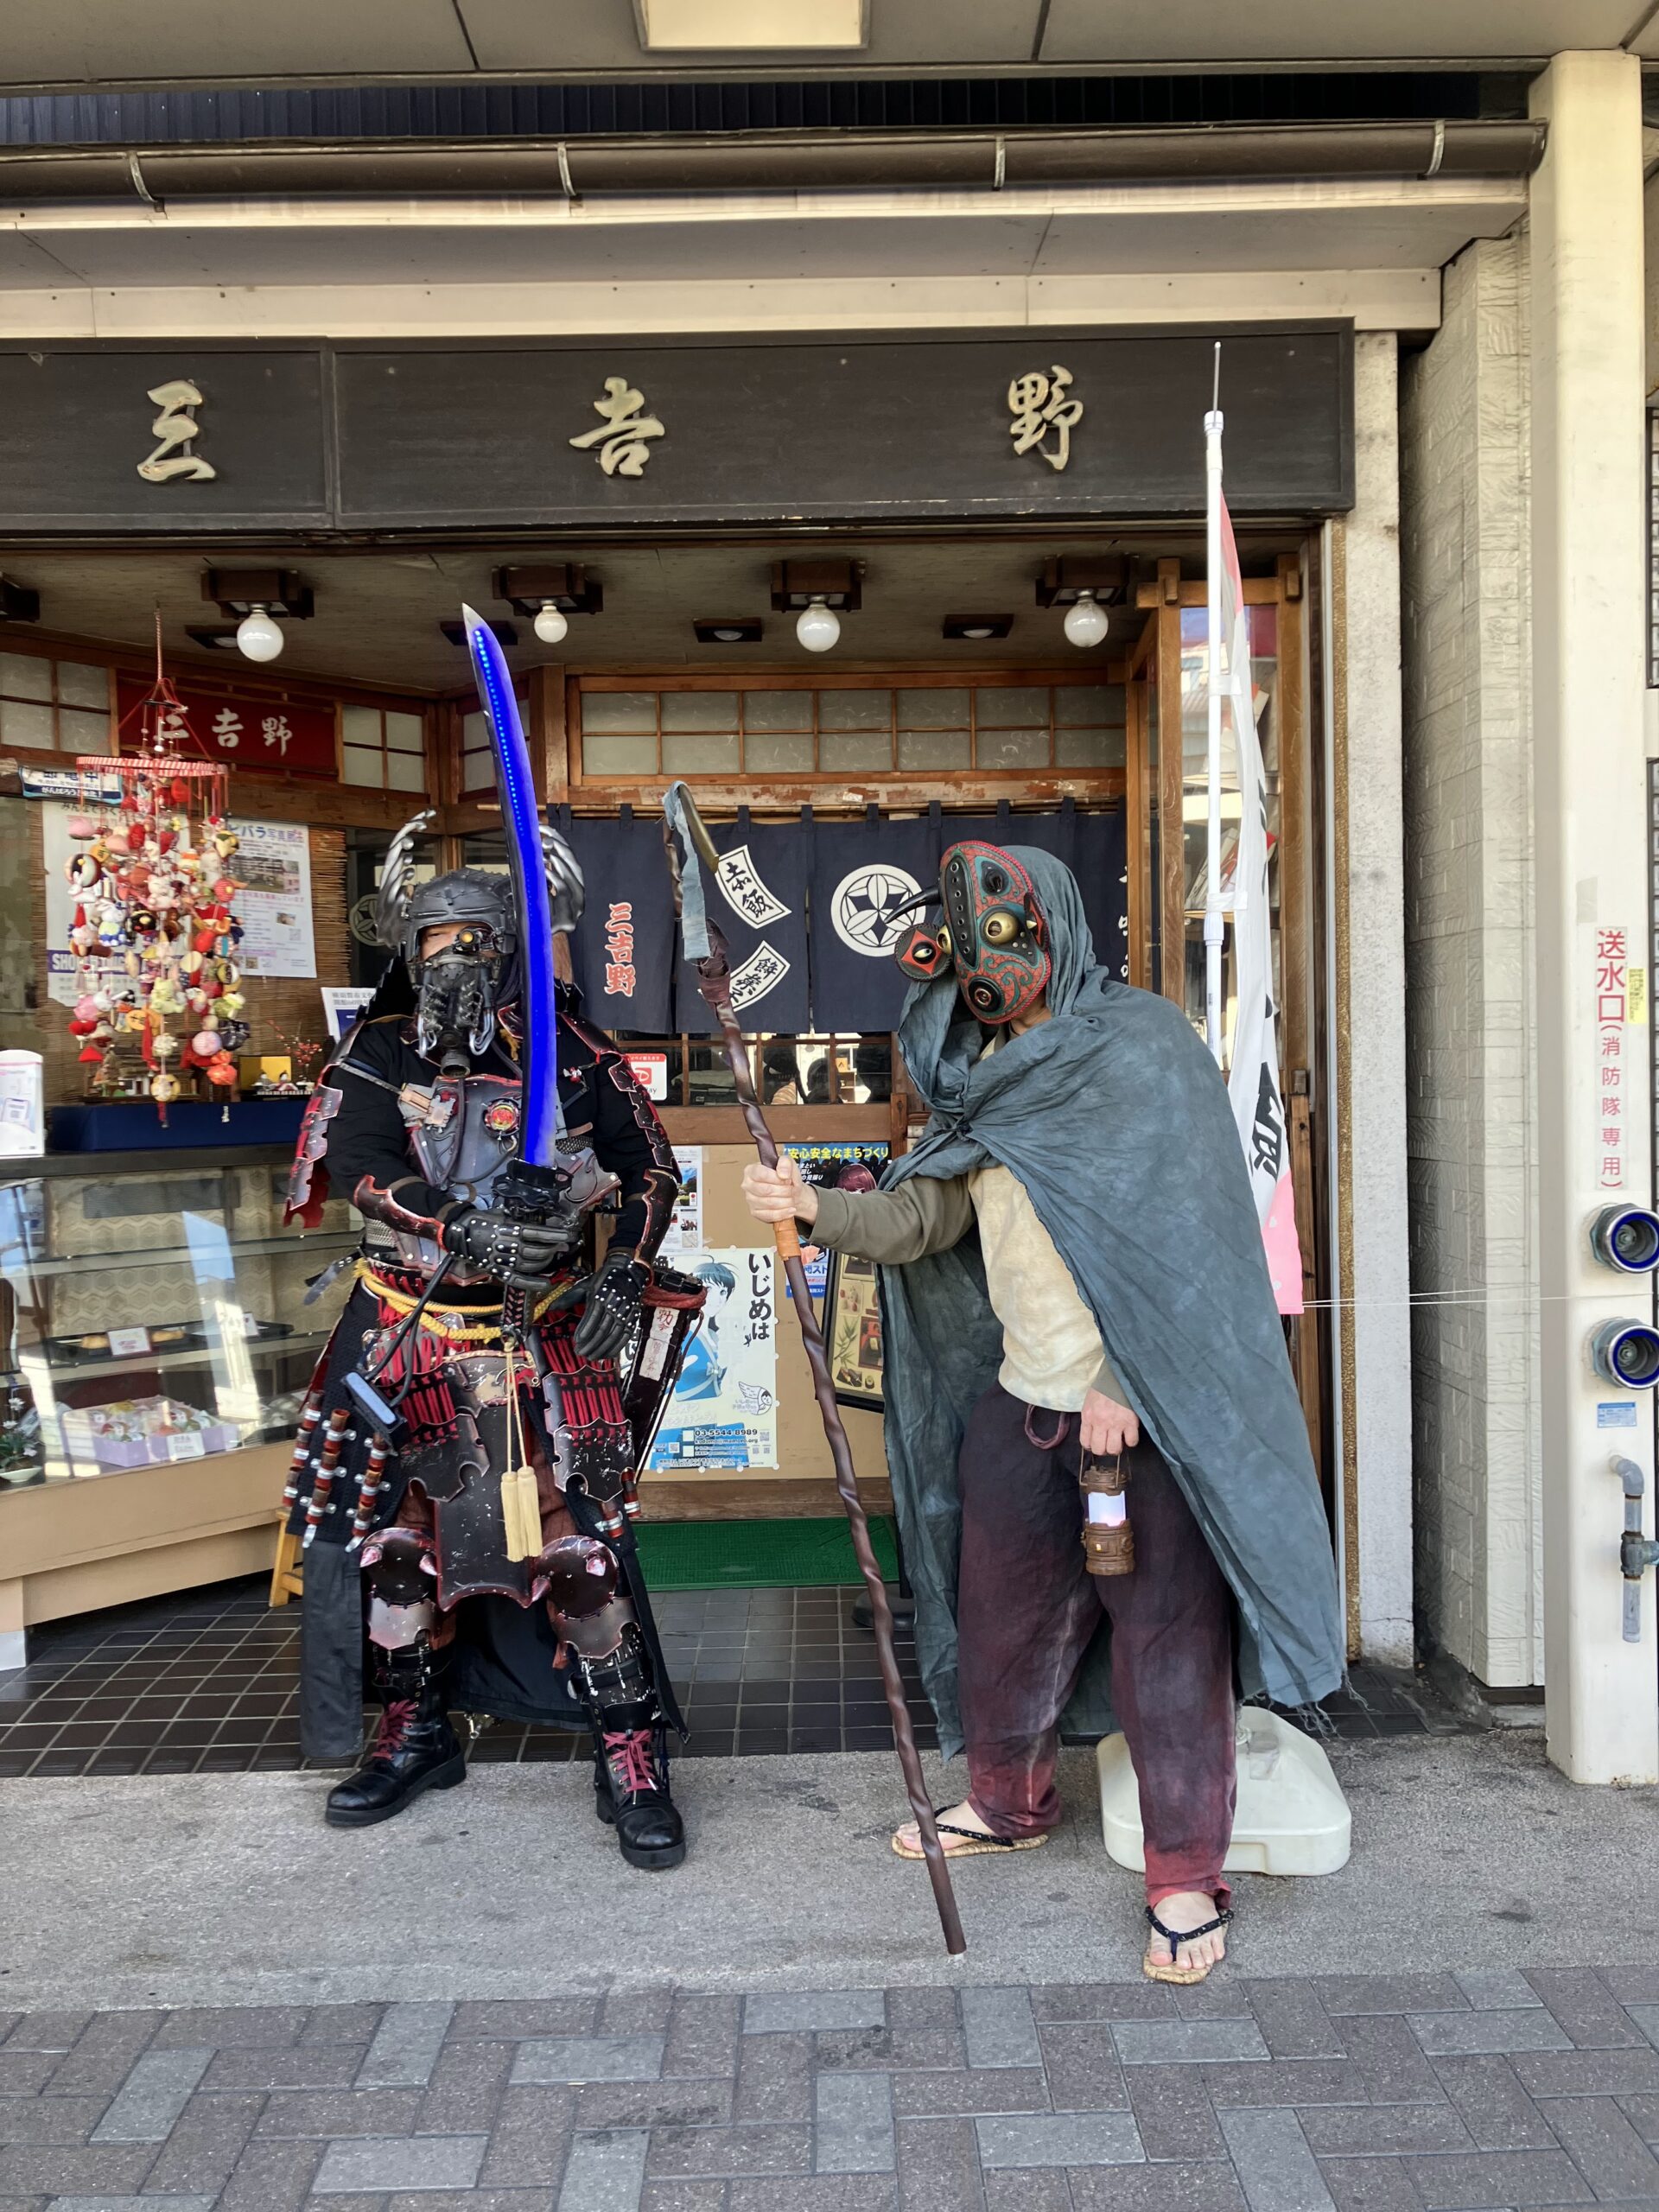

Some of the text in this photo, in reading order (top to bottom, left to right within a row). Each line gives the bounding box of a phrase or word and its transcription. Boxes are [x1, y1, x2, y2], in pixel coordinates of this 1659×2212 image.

[604, 901, 636, 997] 三吉野
[789, 1147, 888, 1160] 安心安全なまちづくり
[748, 1253, 772, 1340] いじめは
